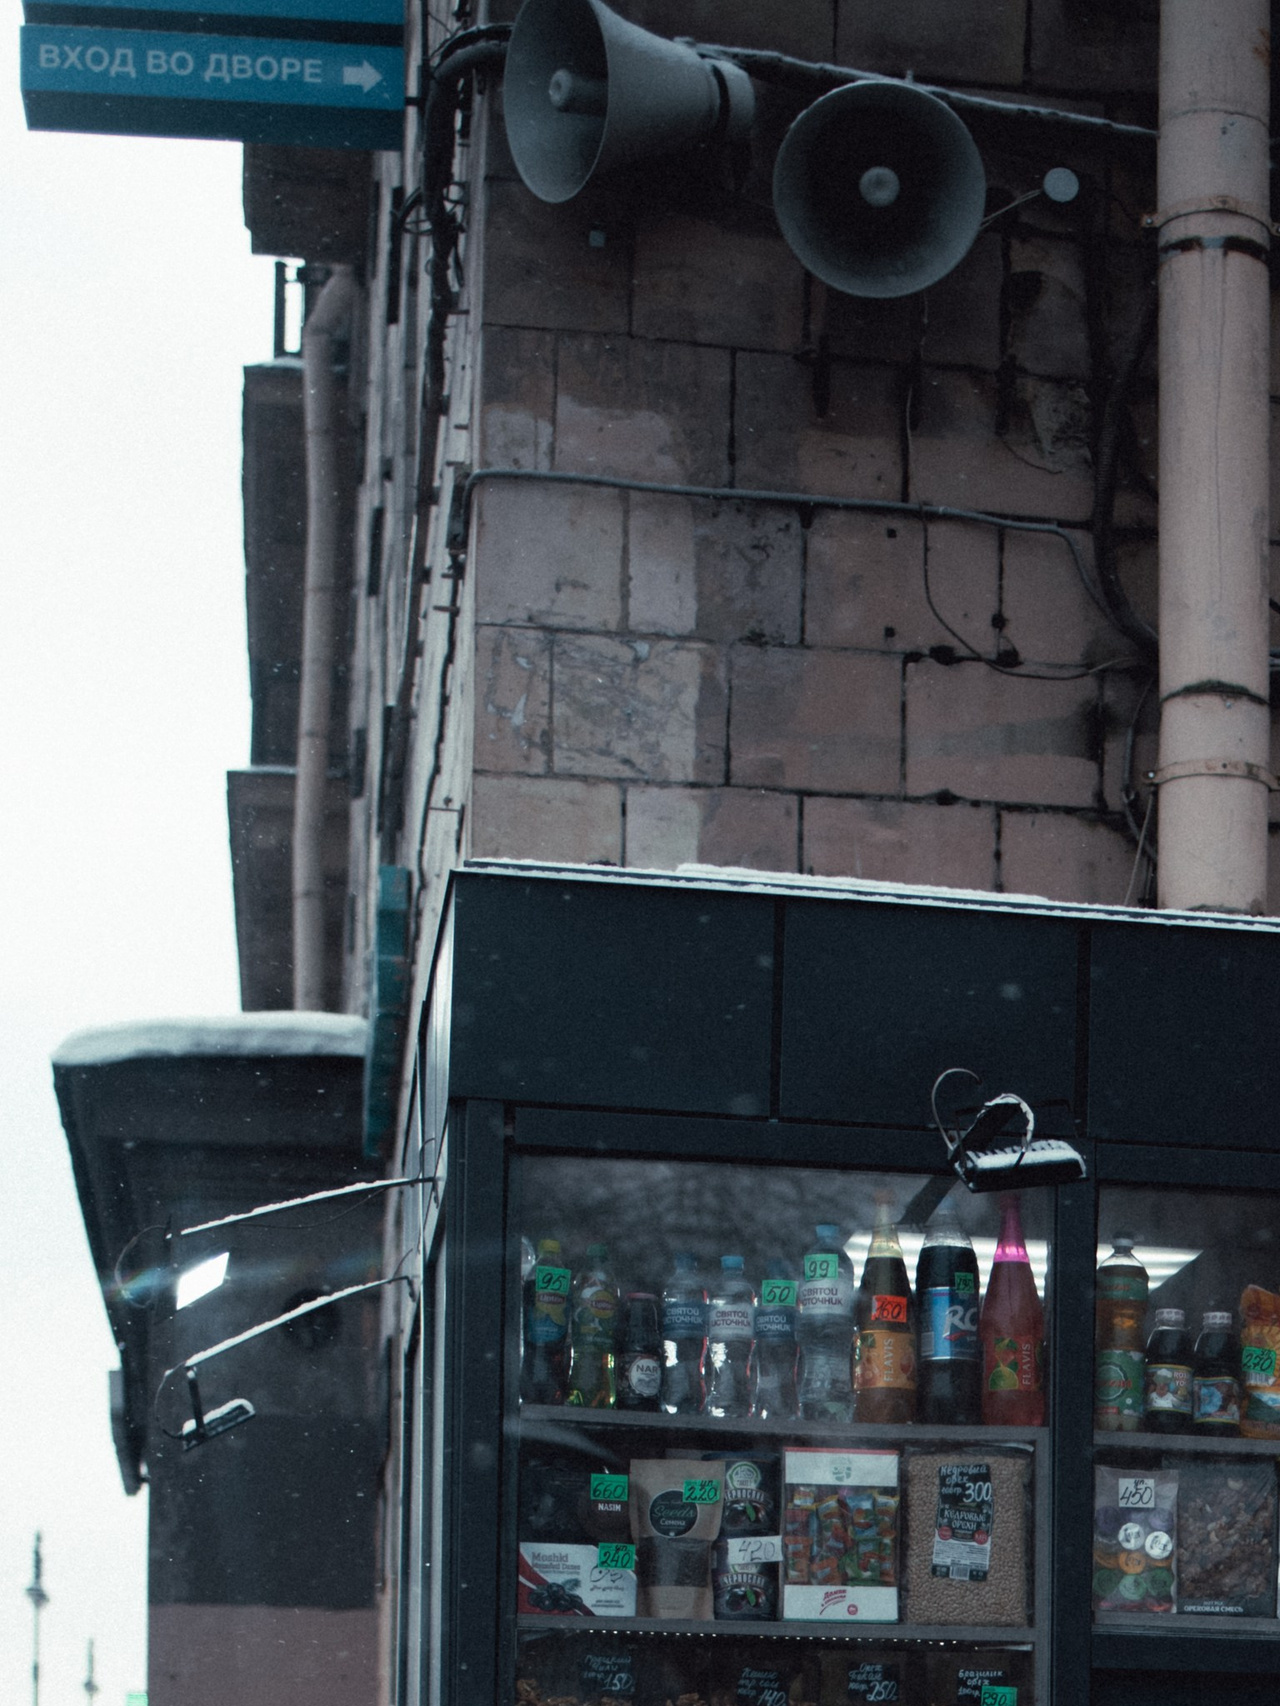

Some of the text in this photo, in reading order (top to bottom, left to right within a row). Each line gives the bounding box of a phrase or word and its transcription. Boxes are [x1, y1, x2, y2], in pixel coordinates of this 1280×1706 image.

[38, 43, 324, 84] ВХОД ВО ДВОРЕ
[808, 1260, 832, 1278] 99
[768, 1285, 793, 1304] 50
[882, 1338, 895, 1383] FLAVIS
[1021, 1343, 1032, 1386] FLAVIS
[593, 1482, 625, 1499] 660
[1119, 1486, 1152, 1505] 450
[601, 1552, 631, 1569] 240
[738, 1541, 776, 1562] 420
